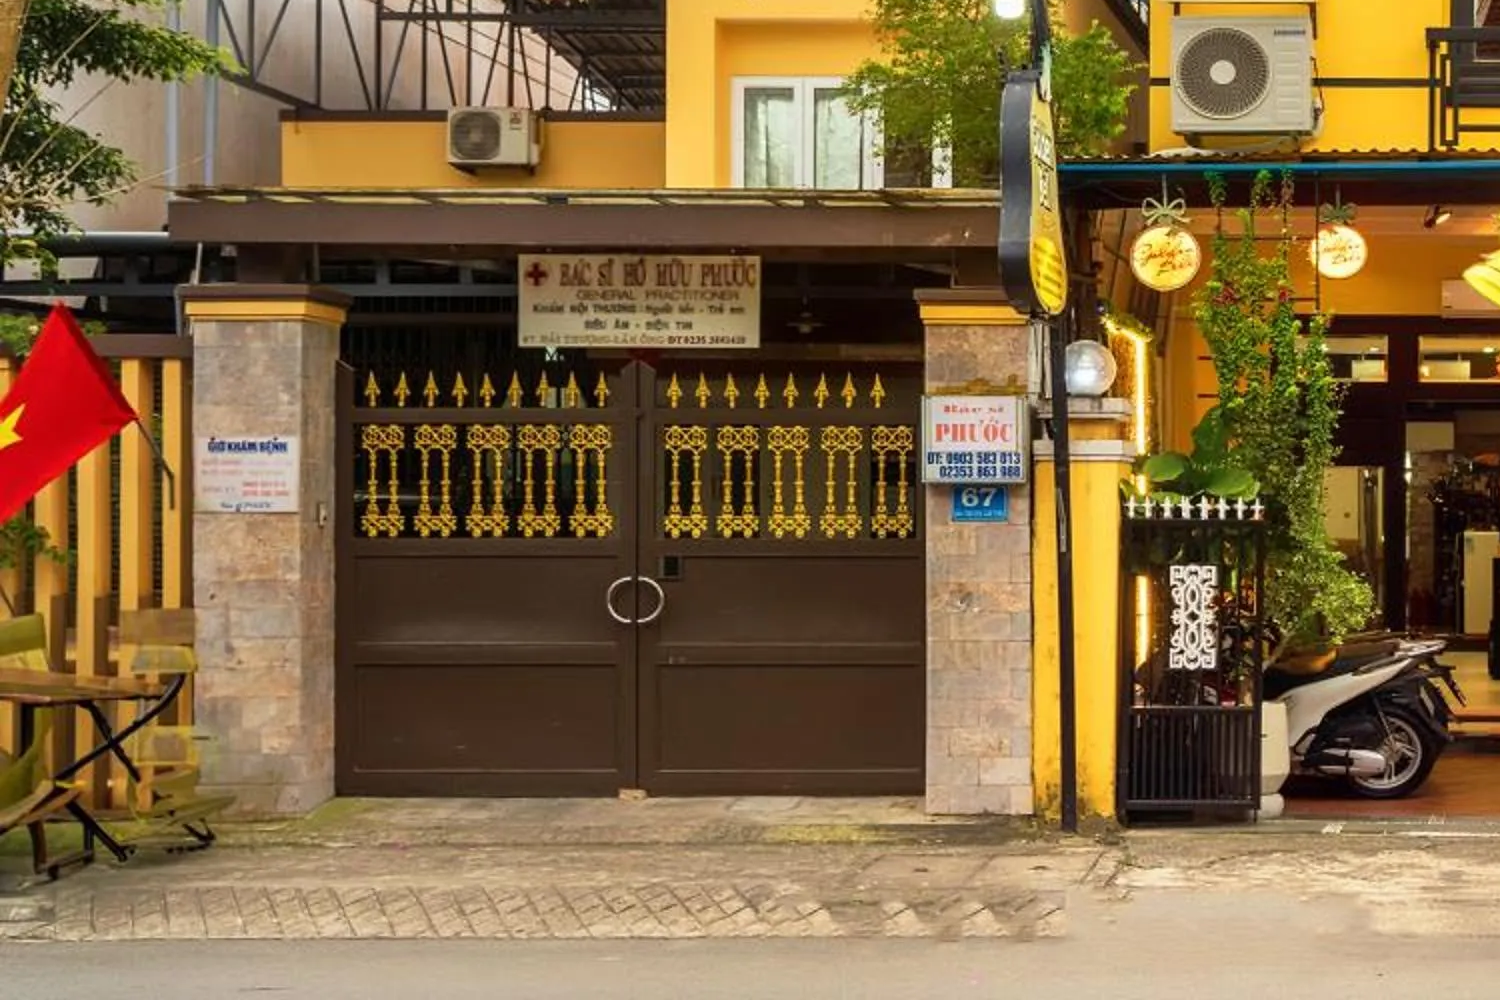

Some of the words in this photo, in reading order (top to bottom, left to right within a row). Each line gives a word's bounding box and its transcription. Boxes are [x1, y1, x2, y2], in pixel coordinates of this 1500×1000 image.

[559, 258, 591, 287] BÁC
[576, 289, 635, 301] GENERAL
[645, 289, 740, 300] PRACTITIONER
[935, 416, 1013, 442] PHƯỚC
[946, 452, 973, 464] 0903
[977, 452, 997, 464] 583
[1000, 452, 1021, 464] 013
[939, 466, 973, 477] 02353
[961, 487, 997, 507] 67
